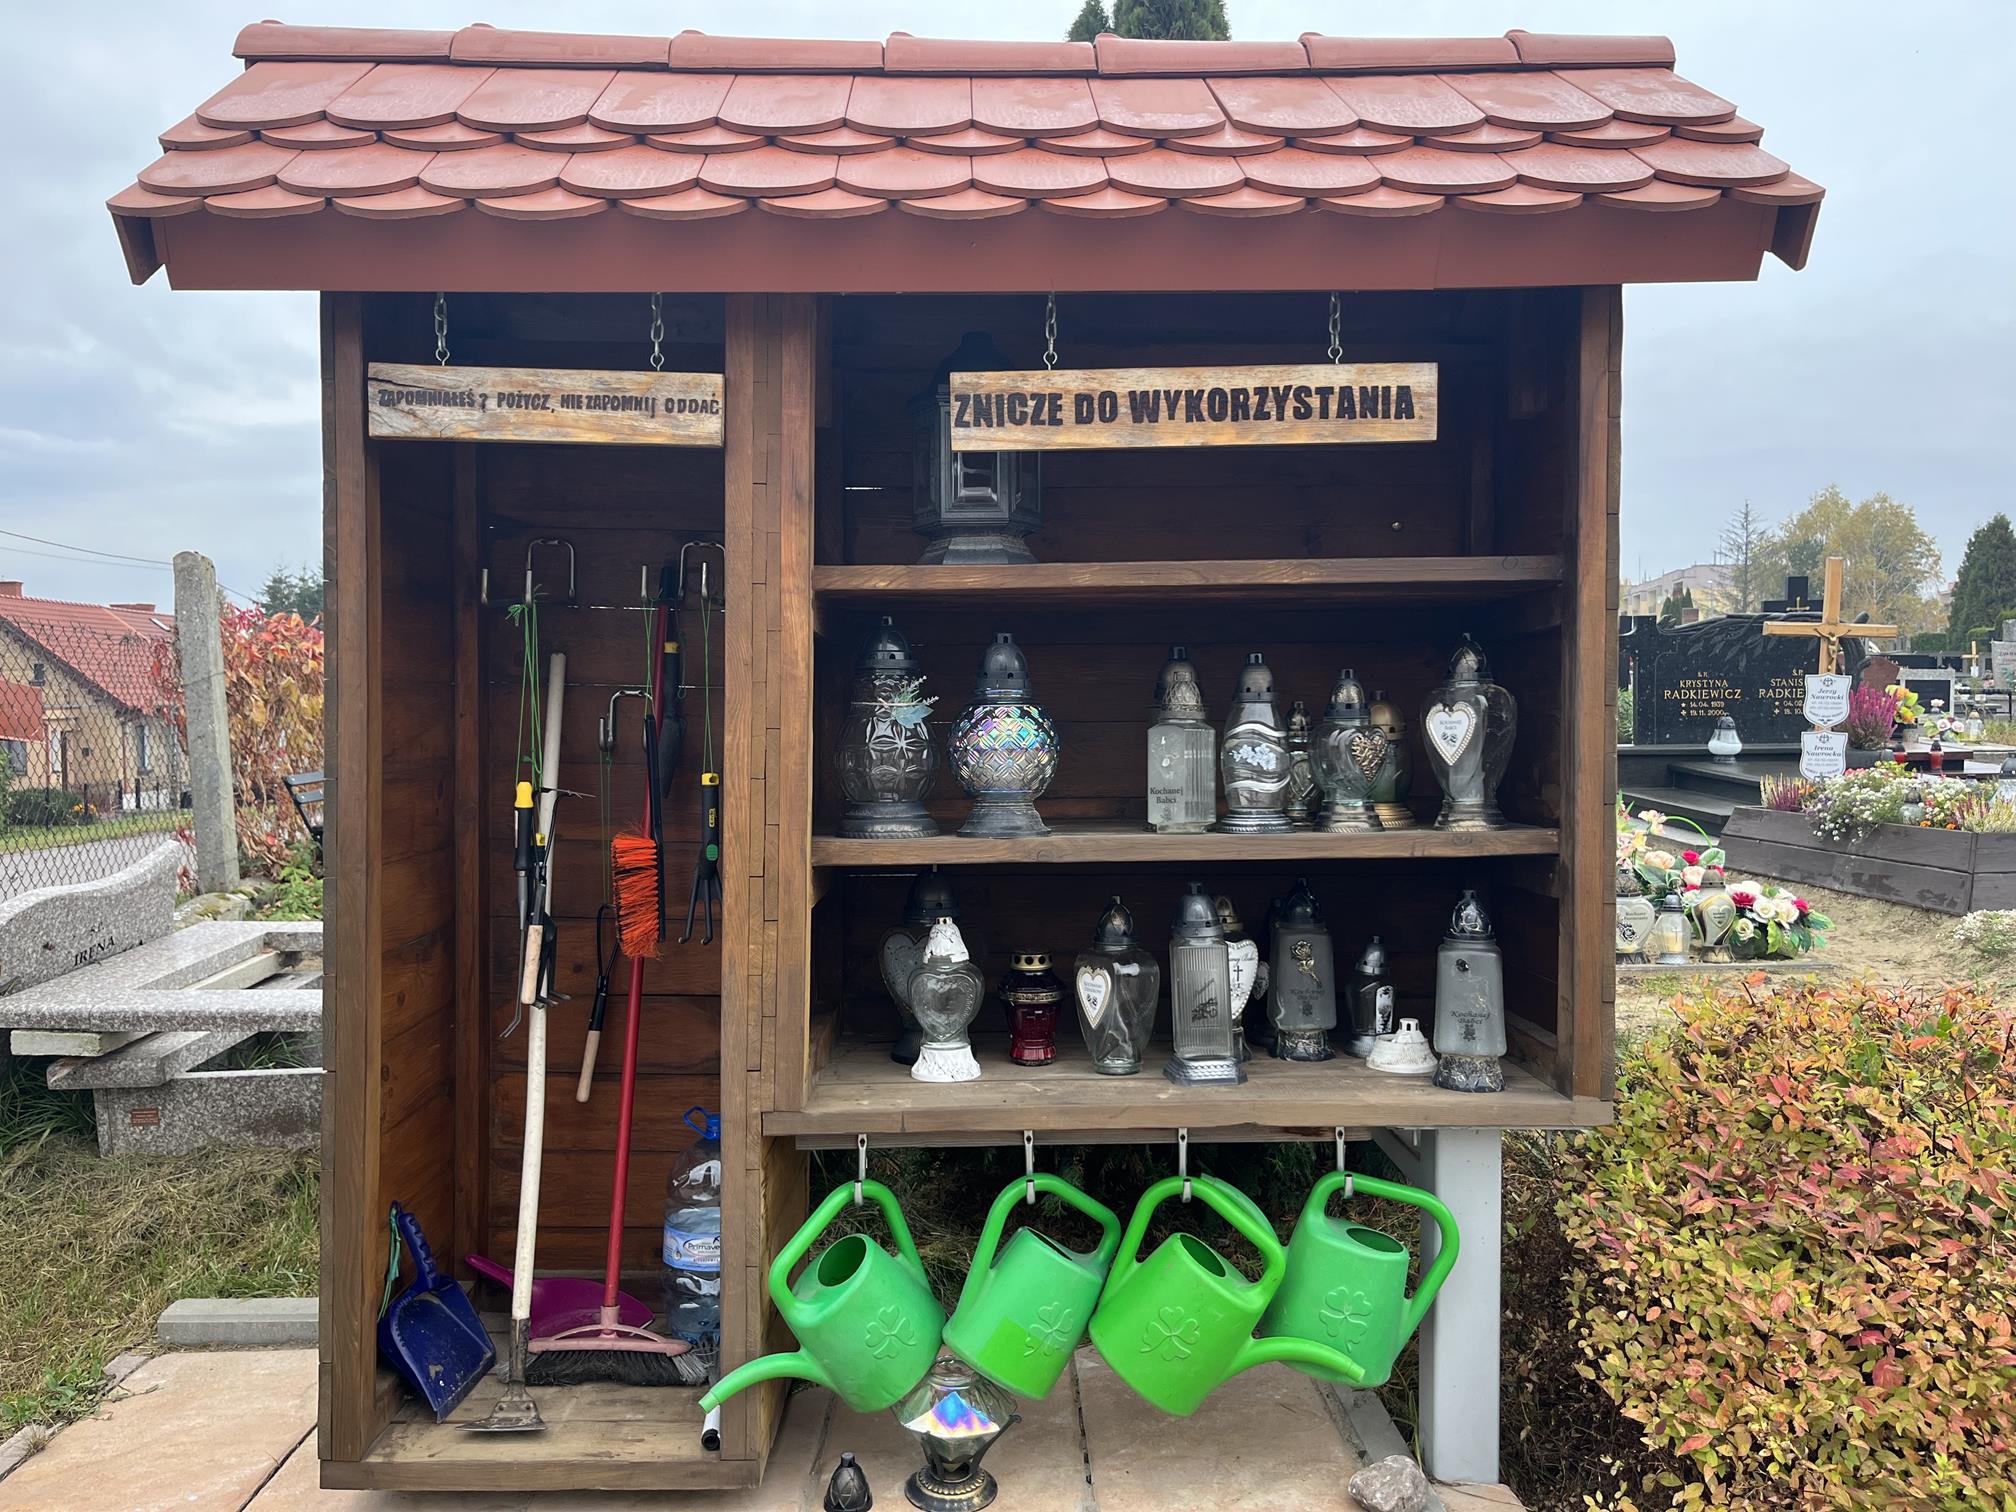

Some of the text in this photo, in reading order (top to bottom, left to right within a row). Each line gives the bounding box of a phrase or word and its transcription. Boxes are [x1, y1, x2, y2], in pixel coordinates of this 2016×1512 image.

[560, 393, 583, 410] NIE
[585, 394, 657, 418] ZAPOMNIJ
[664, 392, 720, 415] ODDAĆ
[953, 384, 1416, 428] ZNICZE DO WYKORZYSTANIA
[1679, 679, 1729, 688] KRYSTYNA
[1770, 678, 1804, 687] STANIS
[1664, 688, 1742, 700] RADKIEWICZ
[1758, 688, 1805, 699] RADKIE
[1149, 786, 1184, 796] Kochanej
[73, 935, 116, 967] IRENA
